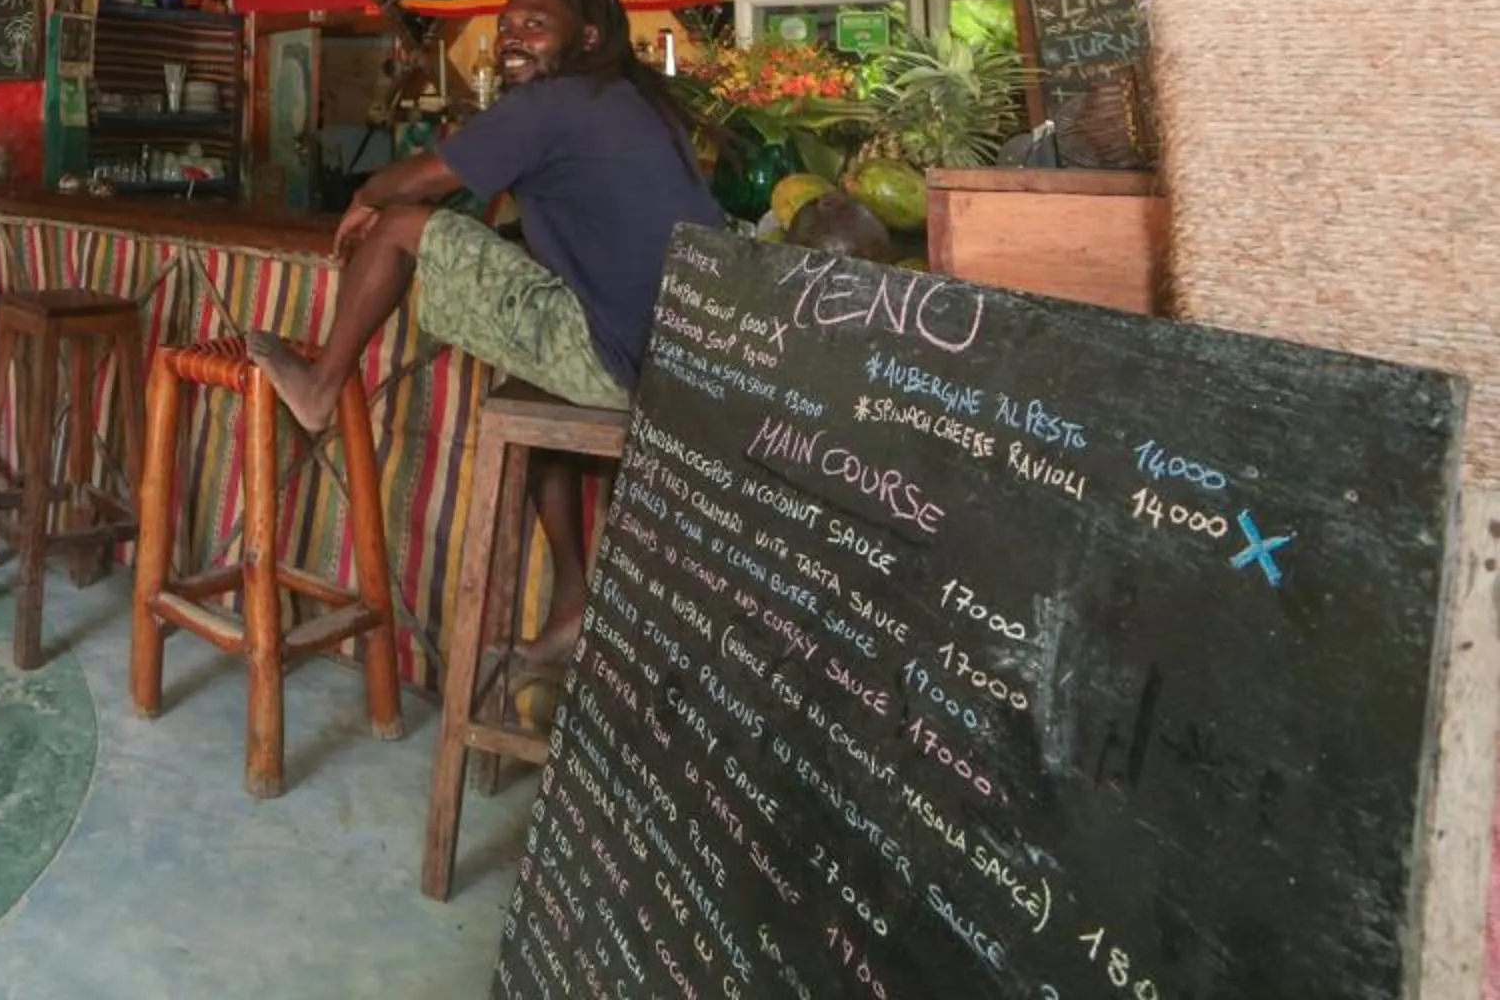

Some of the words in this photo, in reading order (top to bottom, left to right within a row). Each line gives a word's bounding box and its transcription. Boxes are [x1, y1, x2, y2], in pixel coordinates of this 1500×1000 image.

[704, 329, 737, 355] SOUP
[778, 252, 985, 352] MENU
[746, 415, 828, 466] MAIN
[820, 447, 946, 535] COURSE
[870, 397, 932, 434] SPINACH
[933, 415, 996, 458] CHEESE
[1007, 440, 1087, 501] RAVIOLI
[1131, 486, 1229, 539] 14000
[884, 356, 985, 415] AUBERGINE
[1023, 399, 1088, 450] PESTO
[1133, 438, 1228, 490] 14000
[741, 477, 757, 499] IN
[755, 484, 825, 530] COCONUT
[826, 518, 898, 576] SAUCE
[940, 577, 1027, 641] 17000
[754, 528, 790, 560] WITH
[795, 551, 842, 598] TARTA
[849, 590, 911, 645] SAUCE
[937, 641, 1029, 711] 17000
[727, 545, 768, 584] LEMON
[822, 609, 879, 660] SAUCE
[903, 656, 979, 730] 19000
[733, 588, 759, 619] AND
[762, 608, 820, 662] CURRY
[824, 656, 892, 718] SAUCE
[908, 716, 994, 798] 17000
[620, 742, 678, 823] SEAFOOD
[687, 817, 727, 890] PLATE
[643, 619, 691, 671] JUMBO
[699, 664, 765, 739] PRAWNS
[795, 756, 844, 811] LEMON
[926, 882, 1007, 971] SAUCE
[666, 685, 720, 756] CURRY
[723, 754, 780, 827] SAUCE
[808, 843, 889, 938] 27000
[670, 589, 713, 643] KUPAKA
[771, 672, 804, 712] FISH
[828, 722, 898, 788] COCONUT
[900, 782, 967, 855] MASALA
[970, 845, 1052, 935] SAUCE)
[703, 778, 745, 846] TARTA
[655, 870, 691, 928] CAKE
